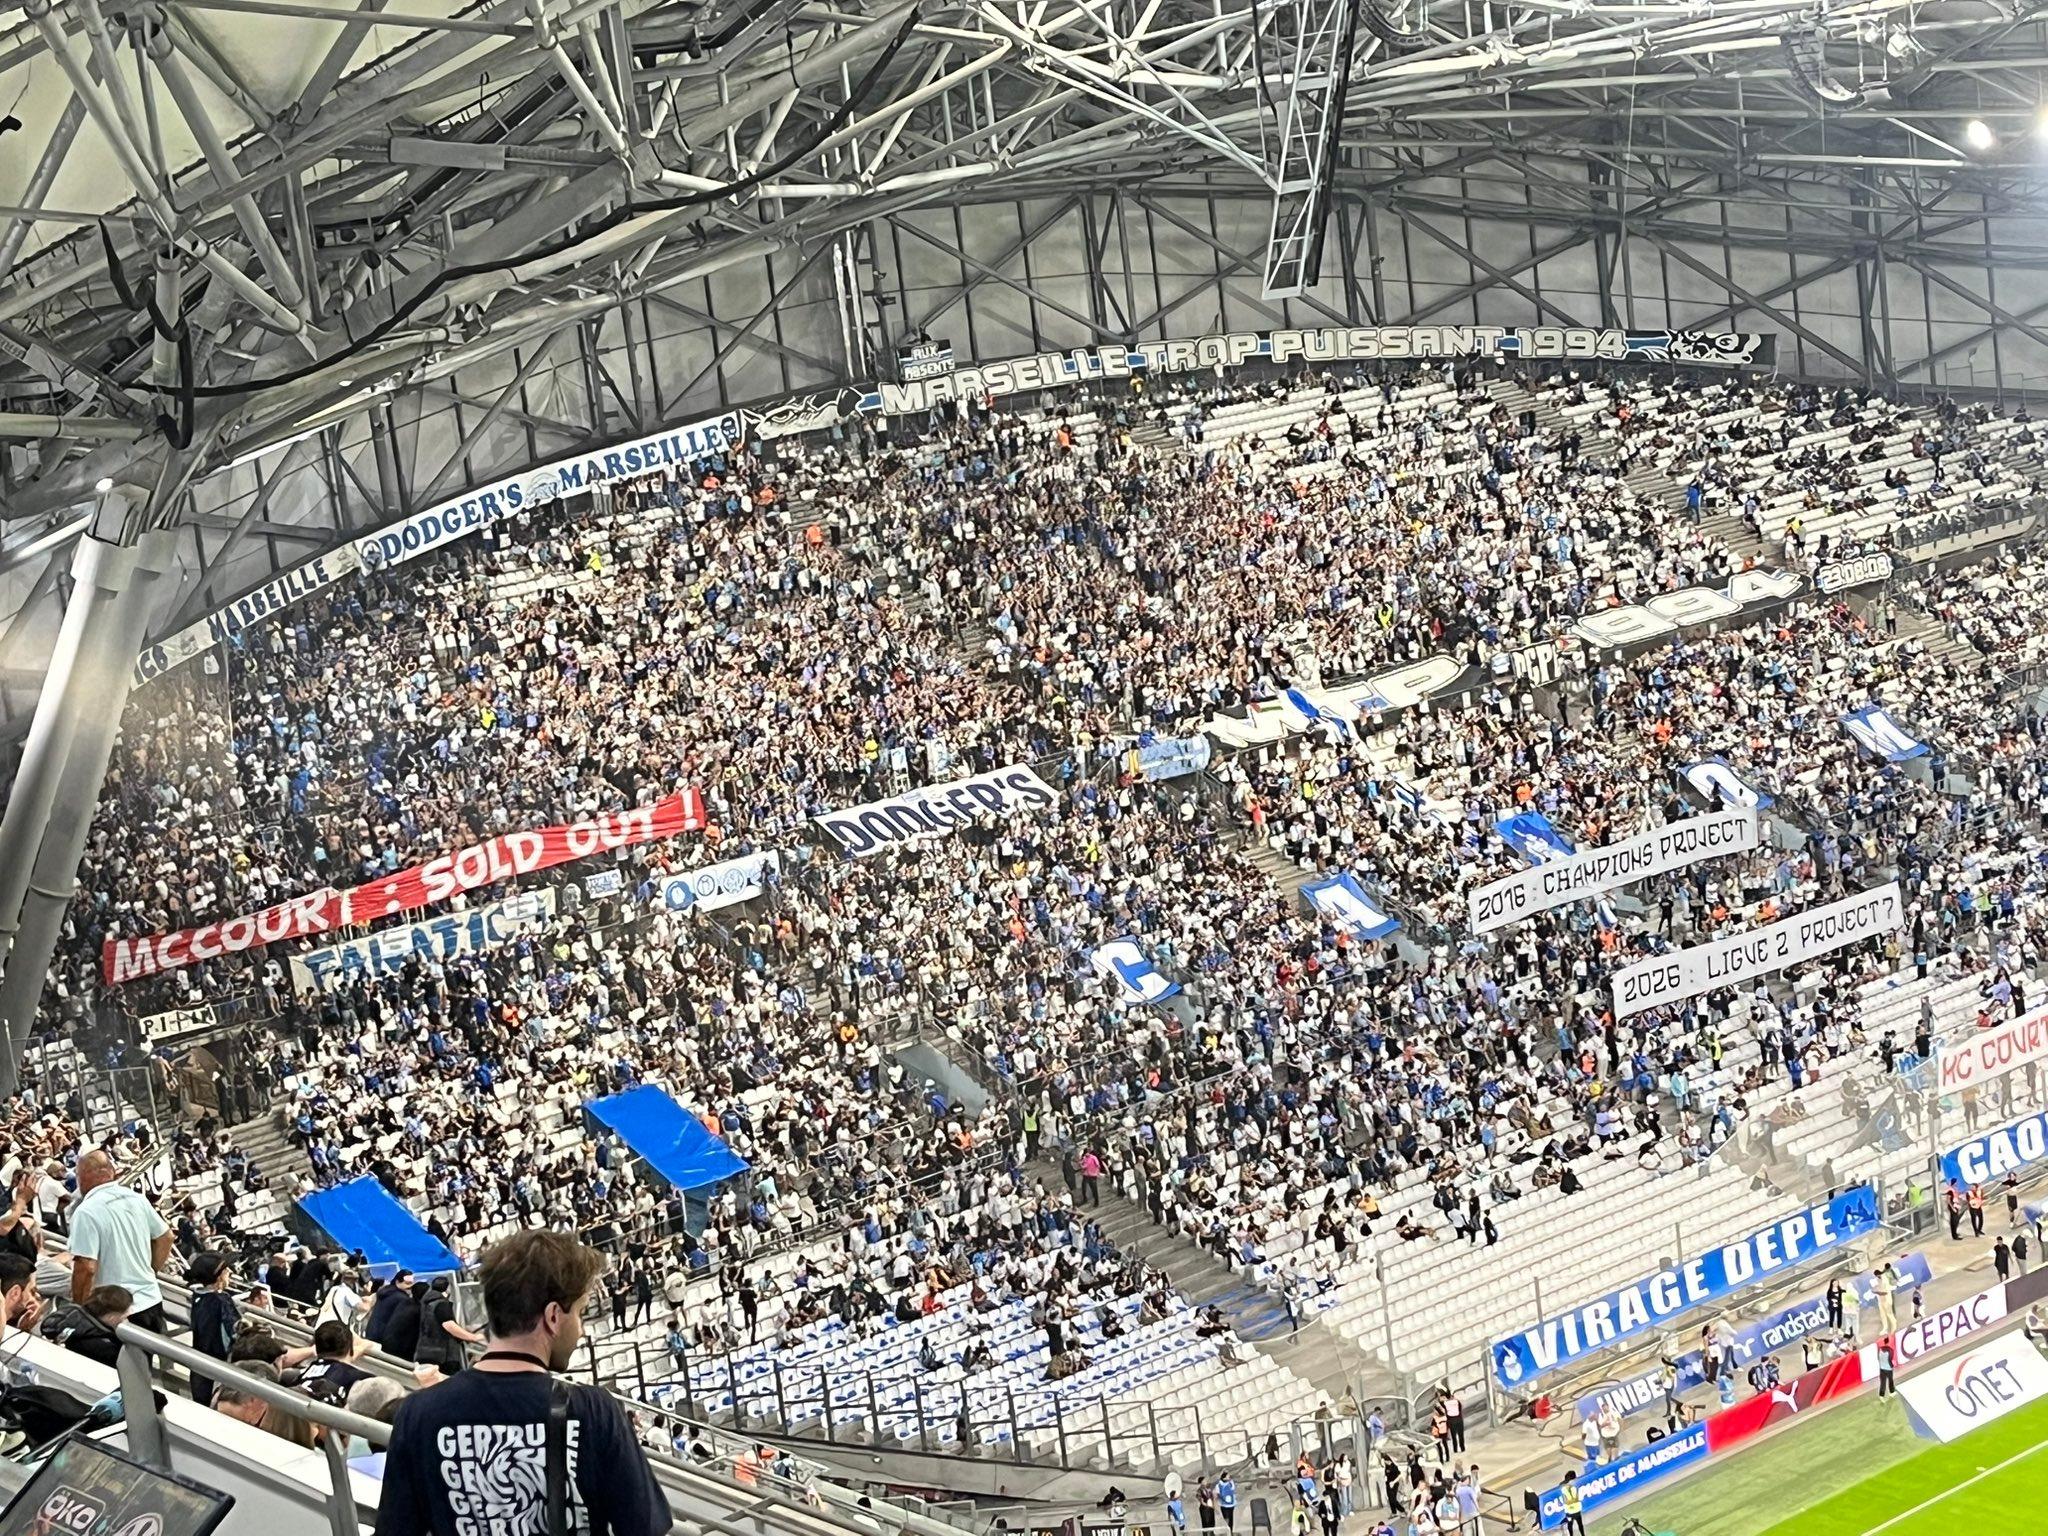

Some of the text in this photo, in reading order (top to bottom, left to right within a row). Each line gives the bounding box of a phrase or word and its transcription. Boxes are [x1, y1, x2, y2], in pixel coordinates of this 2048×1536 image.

[879, 325, 1628, 415] MARSEILLE TROP PUISSANT 1994
[911, 344, 939, 361] AUX
[379, 425, 722, 559] DODGER'S MARSEILLE
[826, 772, 1053, 852] DODGER'S
[113, 887, 358, 983] MCCOURT
[421, 831, 545, 902] SOLD
[565, 808, 658, 856] OUT
[1478, 883, 1526, 922] 2016
[1543, 844, 1653, 897] CHAMPIONS
[1660, 818, 1748, 860] PROJECT
[1624, 963, 1681, 1003] 2026
[1707, 938, 1769, 979] LIGUE
[1775, 931, 1788, 957] 2
[1942, 1048, 1972, 1087] MC
[1524, 1259, 1710, 1370] VIRAGE
[1761, 1300, 1828, 1350] randstad
[1901, 1293, 1990, 1360] CEPAC
[437, 1419, 580, 1465] GERTRUE
[1618, 1462, 1637, 1483] DE
[1637, 1431, 1706, 1474] MARSEILLE
